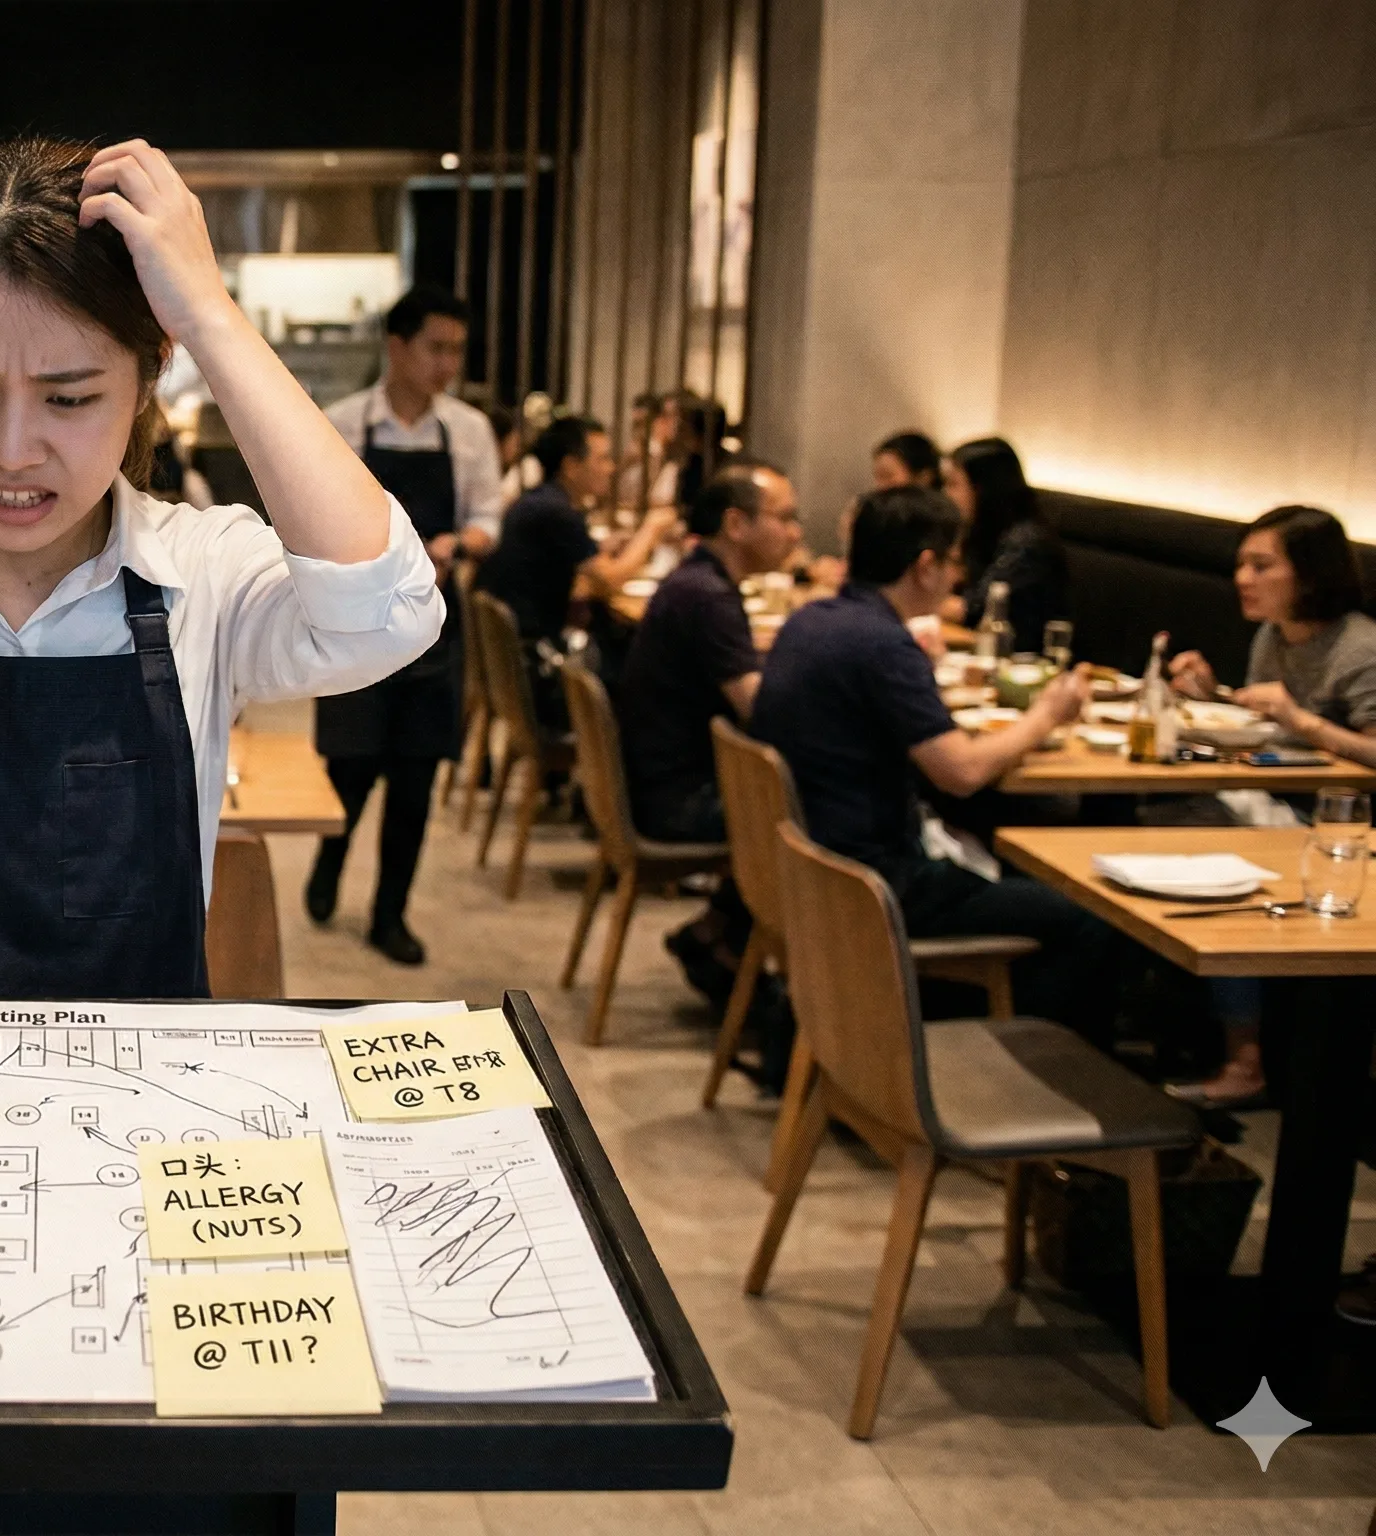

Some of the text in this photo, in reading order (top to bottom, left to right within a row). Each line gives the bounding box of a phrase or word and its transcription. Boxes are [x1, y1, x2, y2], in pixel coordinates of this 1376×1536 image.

[54, 1010, 106, 1024] Plan
[344, 1031, 445, 1057] EXTRA
[353, 1058, 446, 1083] CHAIR
[394, 1081, 480, 1108] @ T8
[163, 1181, 303, 1212] ALLERGY
[192, 1213, 302, 1244] (NUTS)
[173, 1296, 335, 1330] BIRTHDAY
[193, 1340, 227, 1370] @
